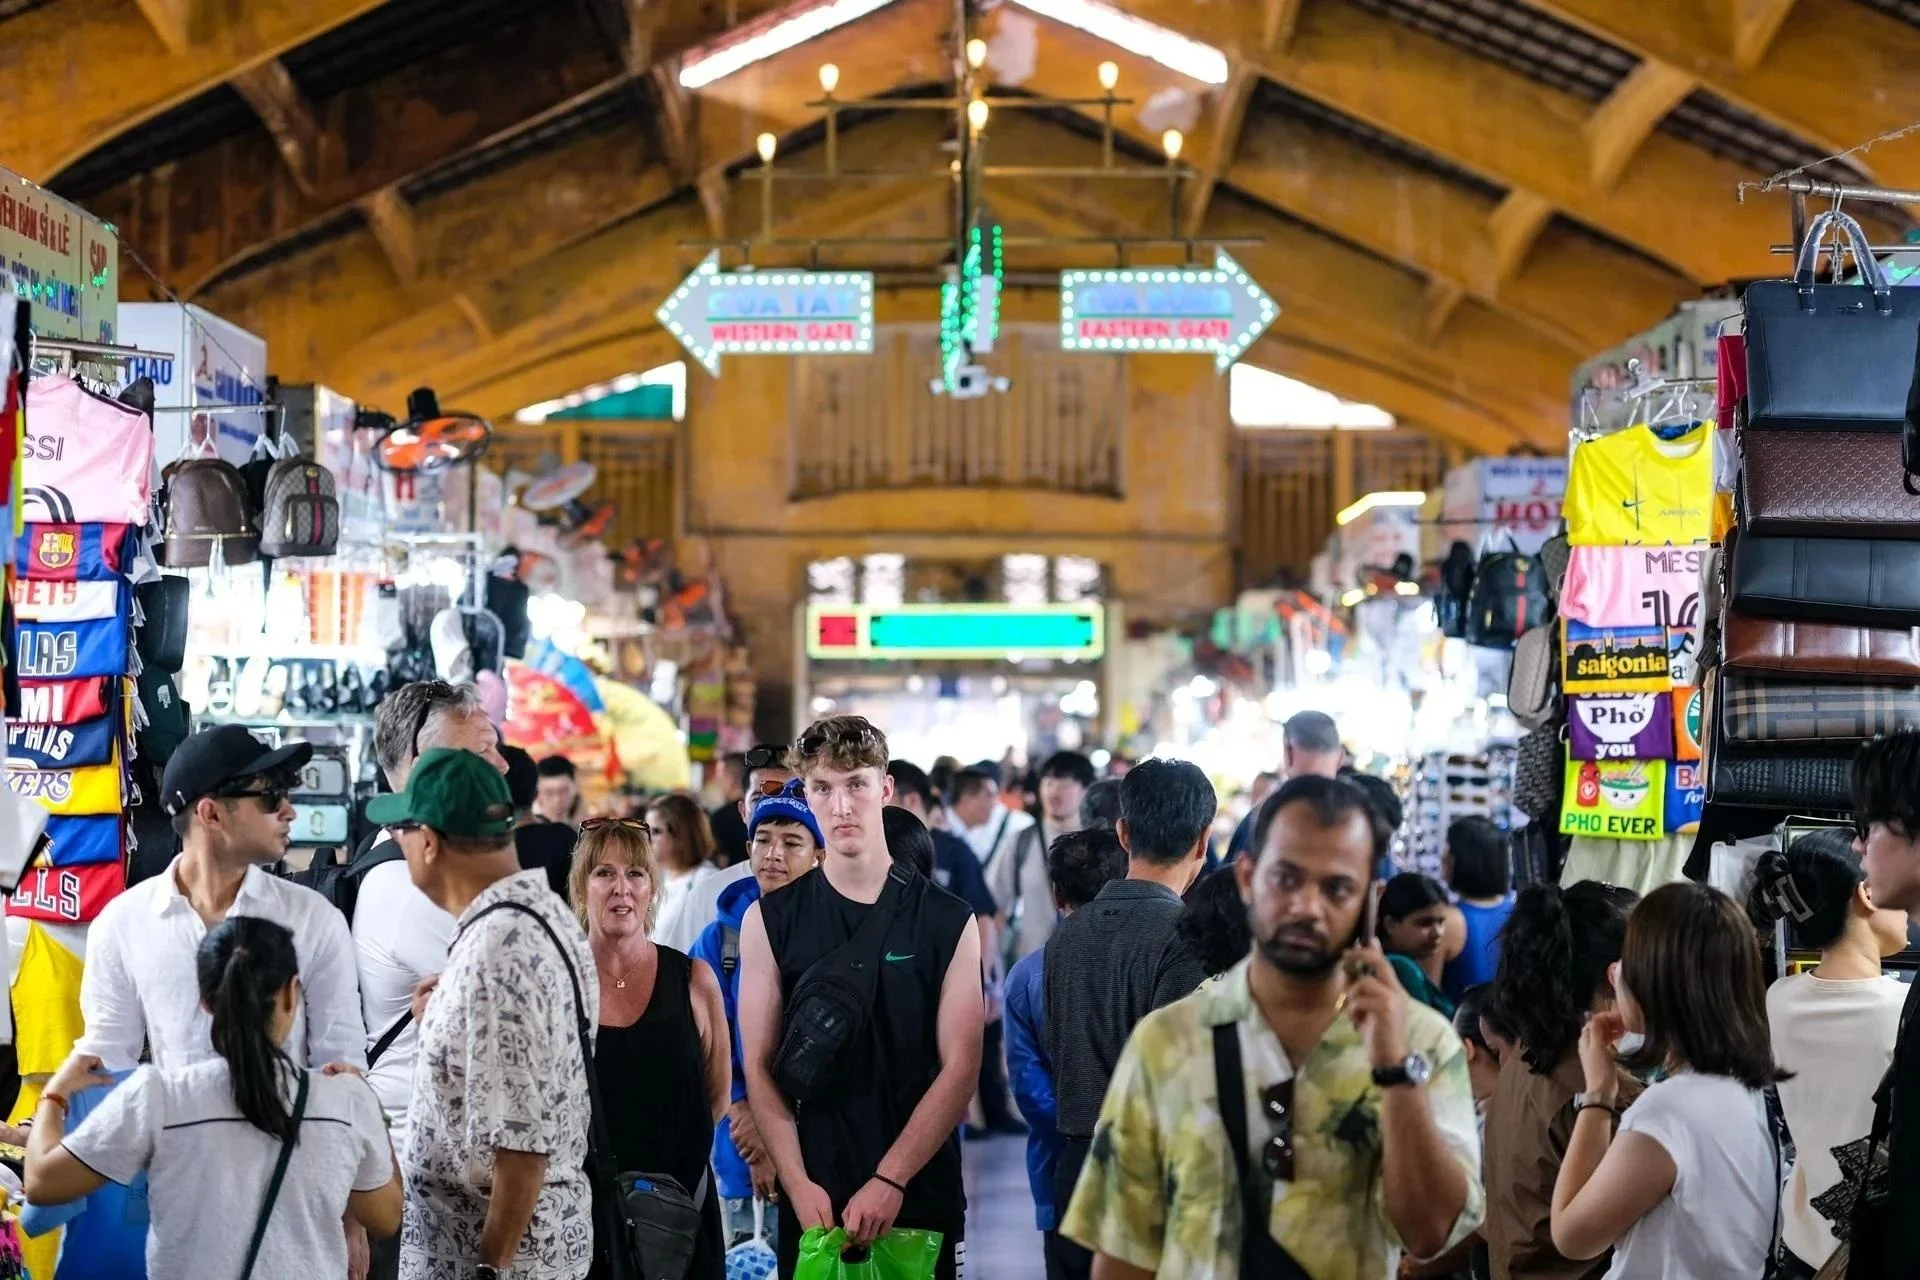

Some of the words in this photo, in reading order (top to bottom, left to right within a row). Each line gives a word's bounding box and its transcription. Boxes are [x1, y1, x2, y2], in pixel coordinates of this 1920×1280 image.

[711, 324, 798, 342] WESTERN
[806, 323, 856, 341] GATE
[1080, 320, 1170, 338] EASTERN
[1177, 320, 1231, 340] GATE
[17, 630, 77, 676] LAS
[1577, 654, 1668, 679] saigonia
[1594, 743, 1637, 760] you
[1565, 812, 1602, 832] PHO
[1607, 815, 1656, 835] EVER
